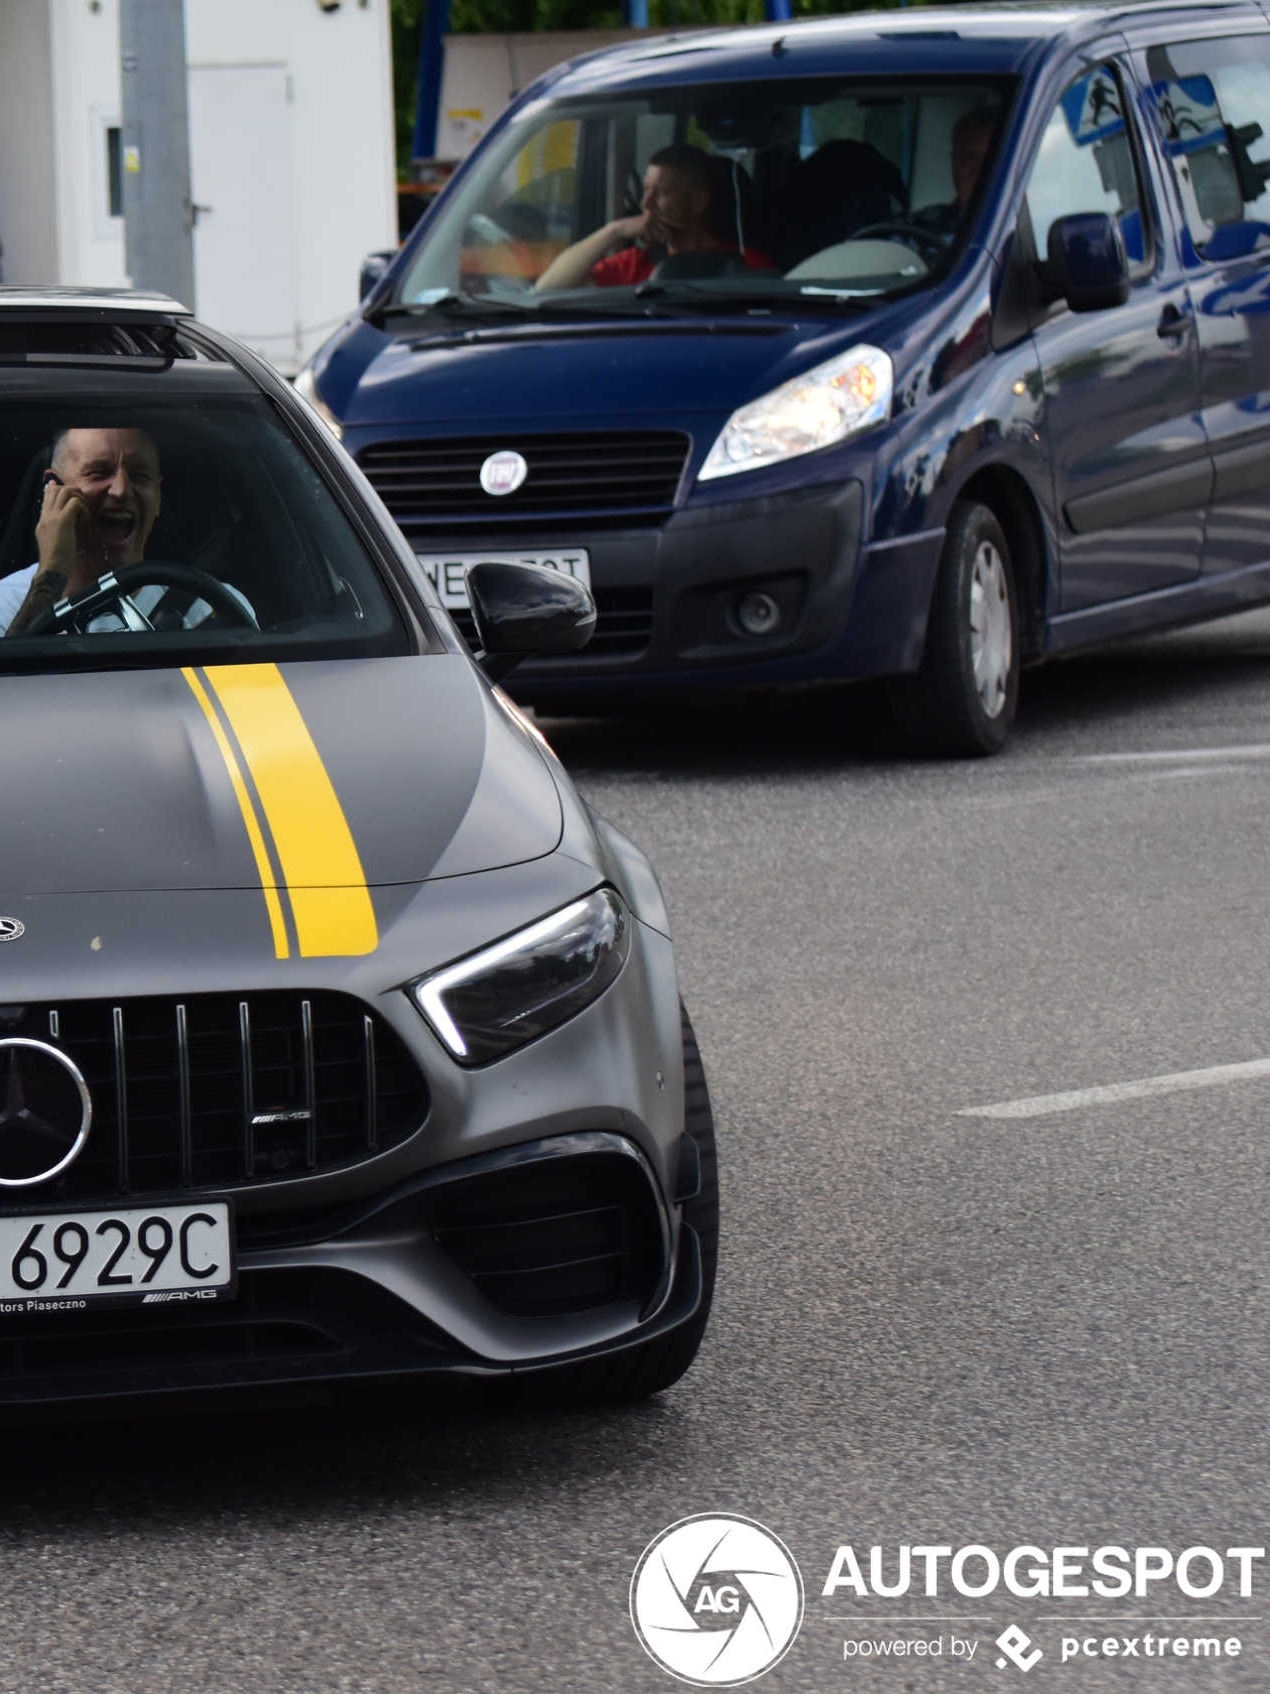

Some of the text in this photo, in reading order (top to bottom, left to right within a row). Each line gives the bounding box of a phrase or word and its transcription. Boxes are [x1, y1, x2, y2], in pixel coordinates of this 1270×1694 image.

[268, 1111, 310, 1121] AMG
[11, 1212, 219, 1291] 6929C
[162, 1289, 217, 1302] AMG
[27, 1299, 87, 1312] Piaseczno
